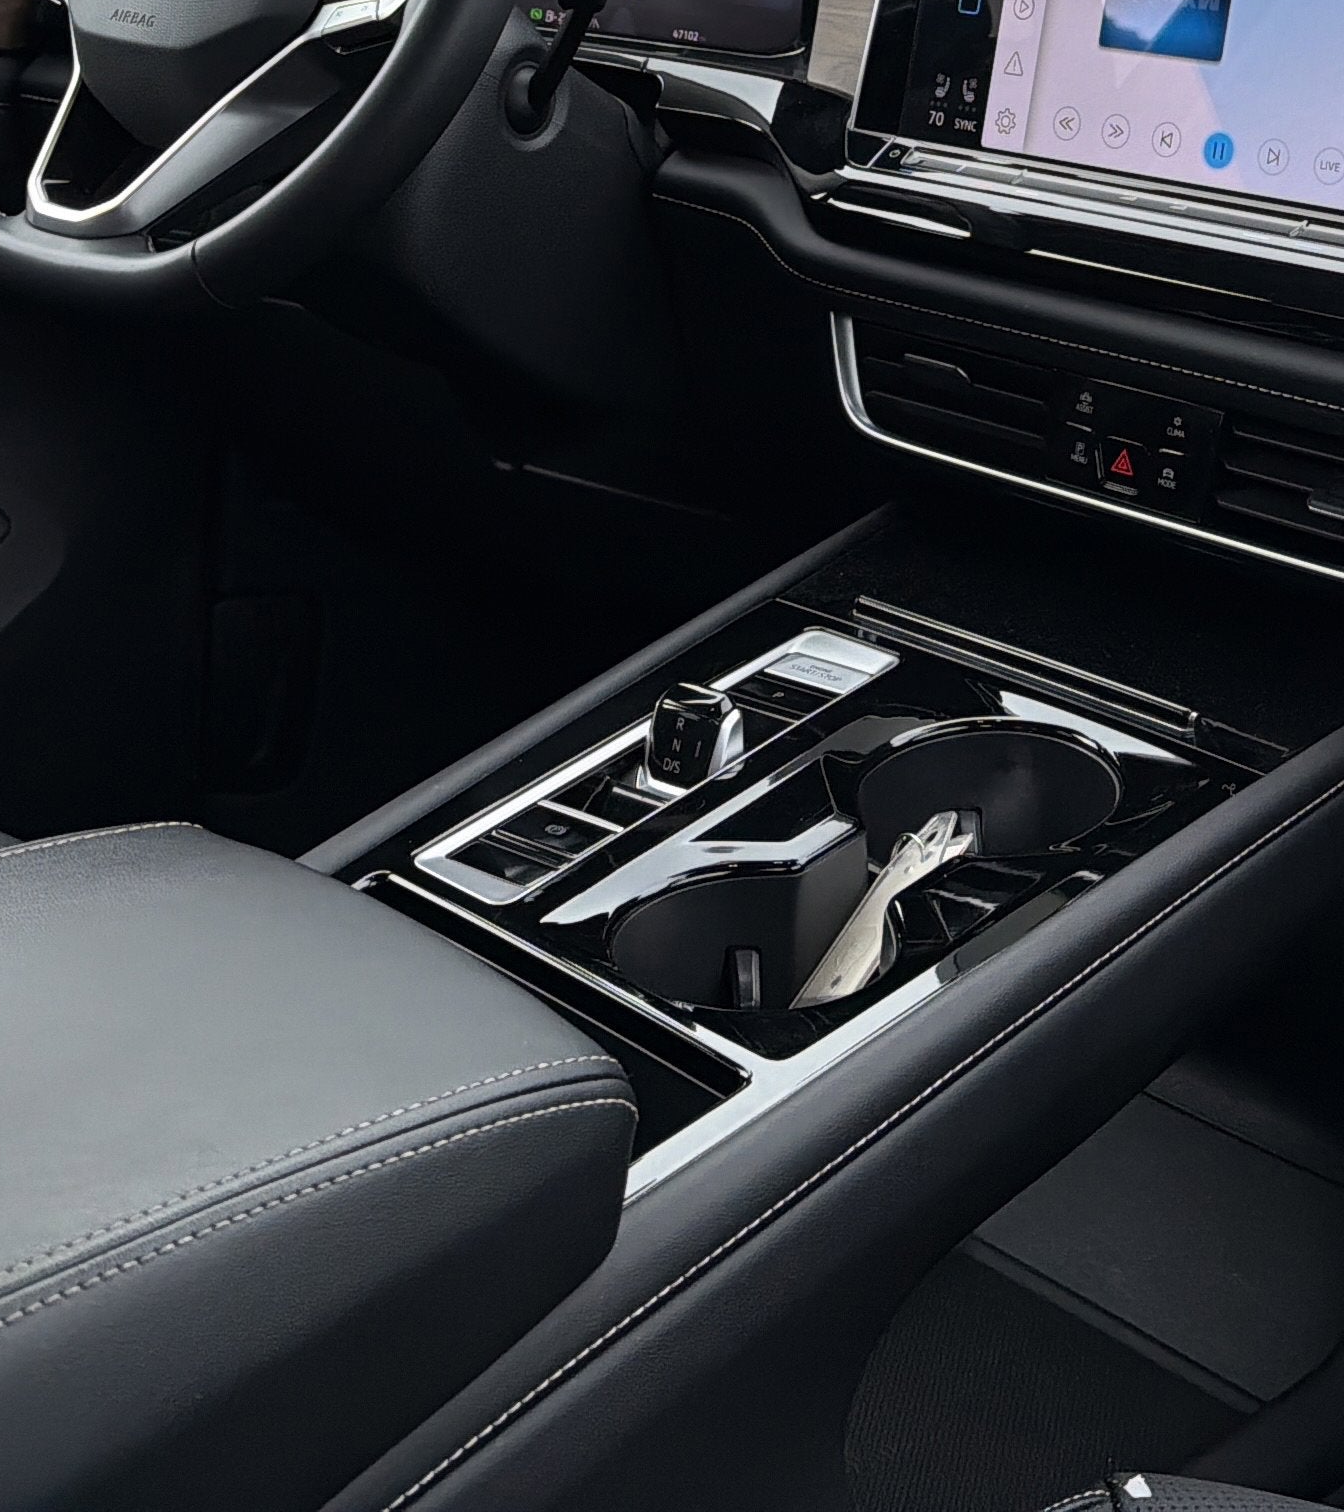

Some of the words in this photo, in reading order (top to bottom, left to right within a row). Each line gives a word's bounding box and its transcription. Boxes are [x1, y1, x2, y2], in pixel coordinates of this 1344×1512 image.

[109, 8, 157, 28] AIRBAG
[928, 110, 945, 126] 70
[953, 117, 978, 133] SYNC
[1319, 159, 1341, 173] LIVE
[1166, 426, 1186, 439] CLIMA
[1070, 453, 1088, 465] MENU
[1157, 477, 1177, 490] MODE
[675, 717, 685, 731] R
[671, 738, 682, 753] N
[662, 757, 681, 774] D/S
